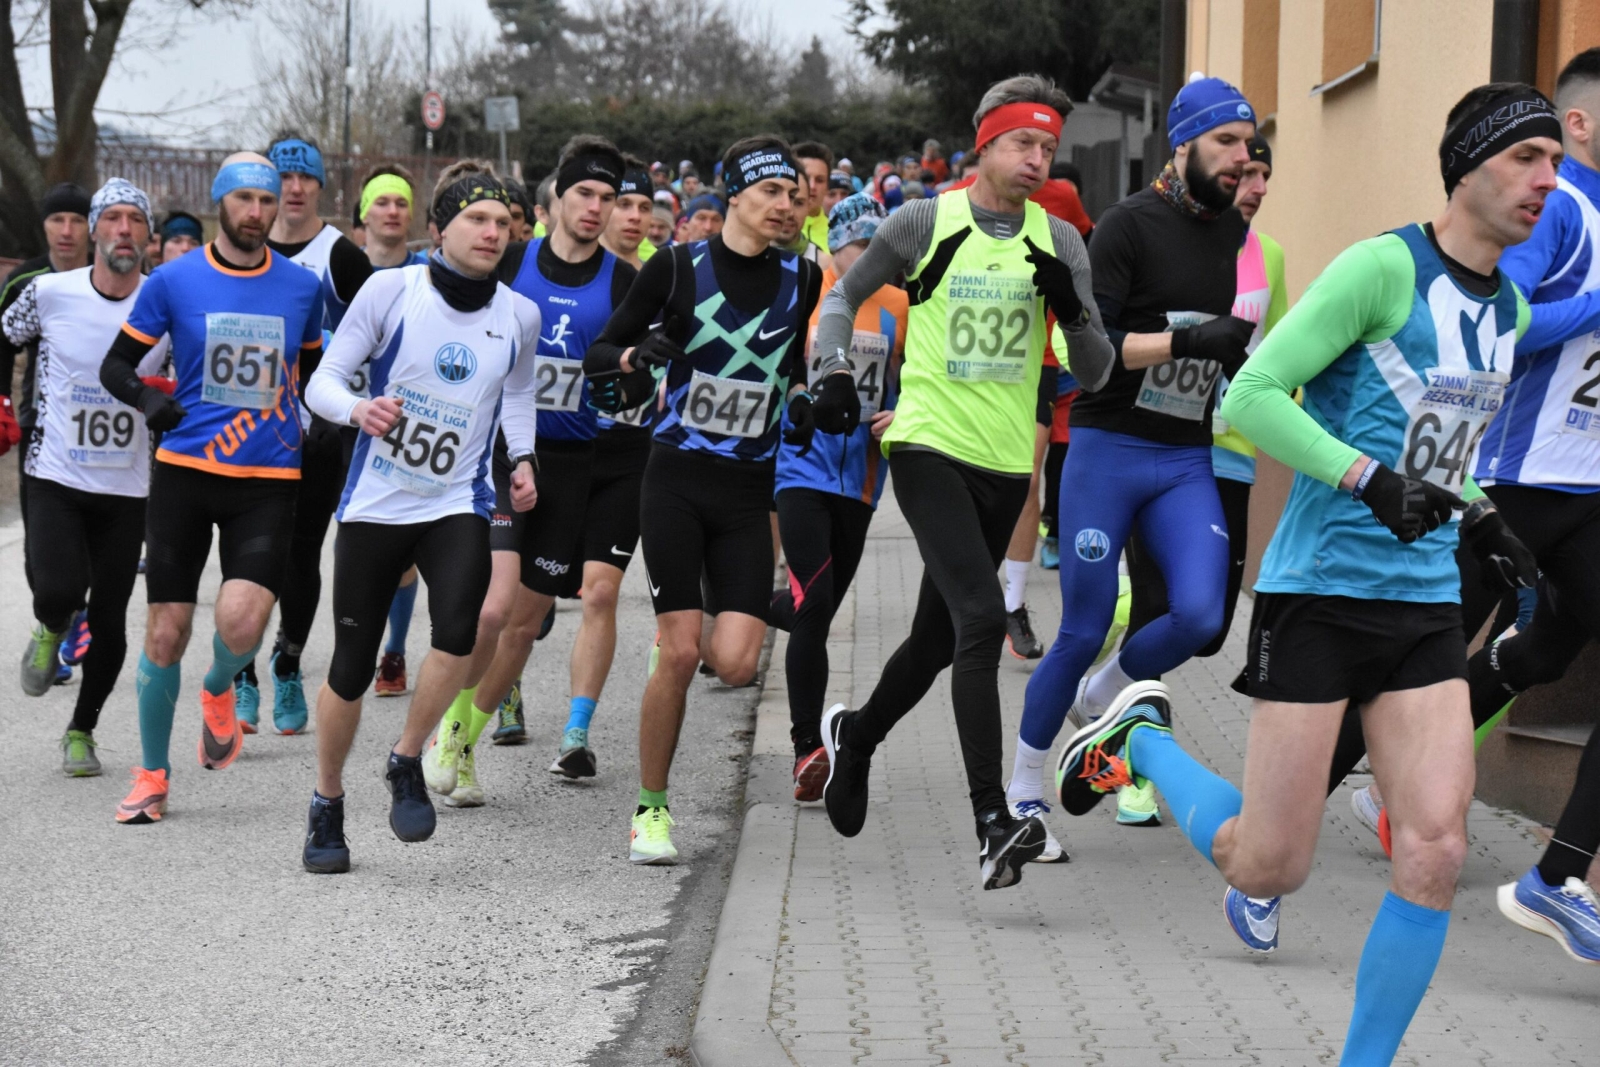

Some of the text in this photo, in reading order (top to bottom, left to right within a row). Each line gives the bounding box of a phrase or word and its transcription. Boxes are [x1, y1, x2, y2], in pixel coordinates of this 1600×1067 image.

[1454, 97, 1556, 153] VIKIN
[740, 152, 782, 173] HRADECKÝ
[950, 274, 987, 286] ZIMNÍ
[548, 295, 573, 305] CRAFT
[949, 286, 1033, 302] BĚŽECKÁ LIGA
[258, 330, 281, 340] LIGA
[949, 305, 1030, 358] 632
[862, 346, 886, 356] LIGA
[210, 343, 279, 389] 651
[72, 384, 102, 395] ZIMNÍ
[535, 363, 582, 407] 27
[1431, 374, 1470, 391] ZIMNÍ
[71, 393, 115, 405] BĚŽECKÁ
[395, 384, 430, 404] ZIMNÍ
[1421, 389, 1478, 409] BĚŽECKÁ
[689, 381, 766, 433] 647
[72, 409, 134, 448] 169
[442, 413, 467, 430] LIGA
[381, 415, 461, 476] 456
